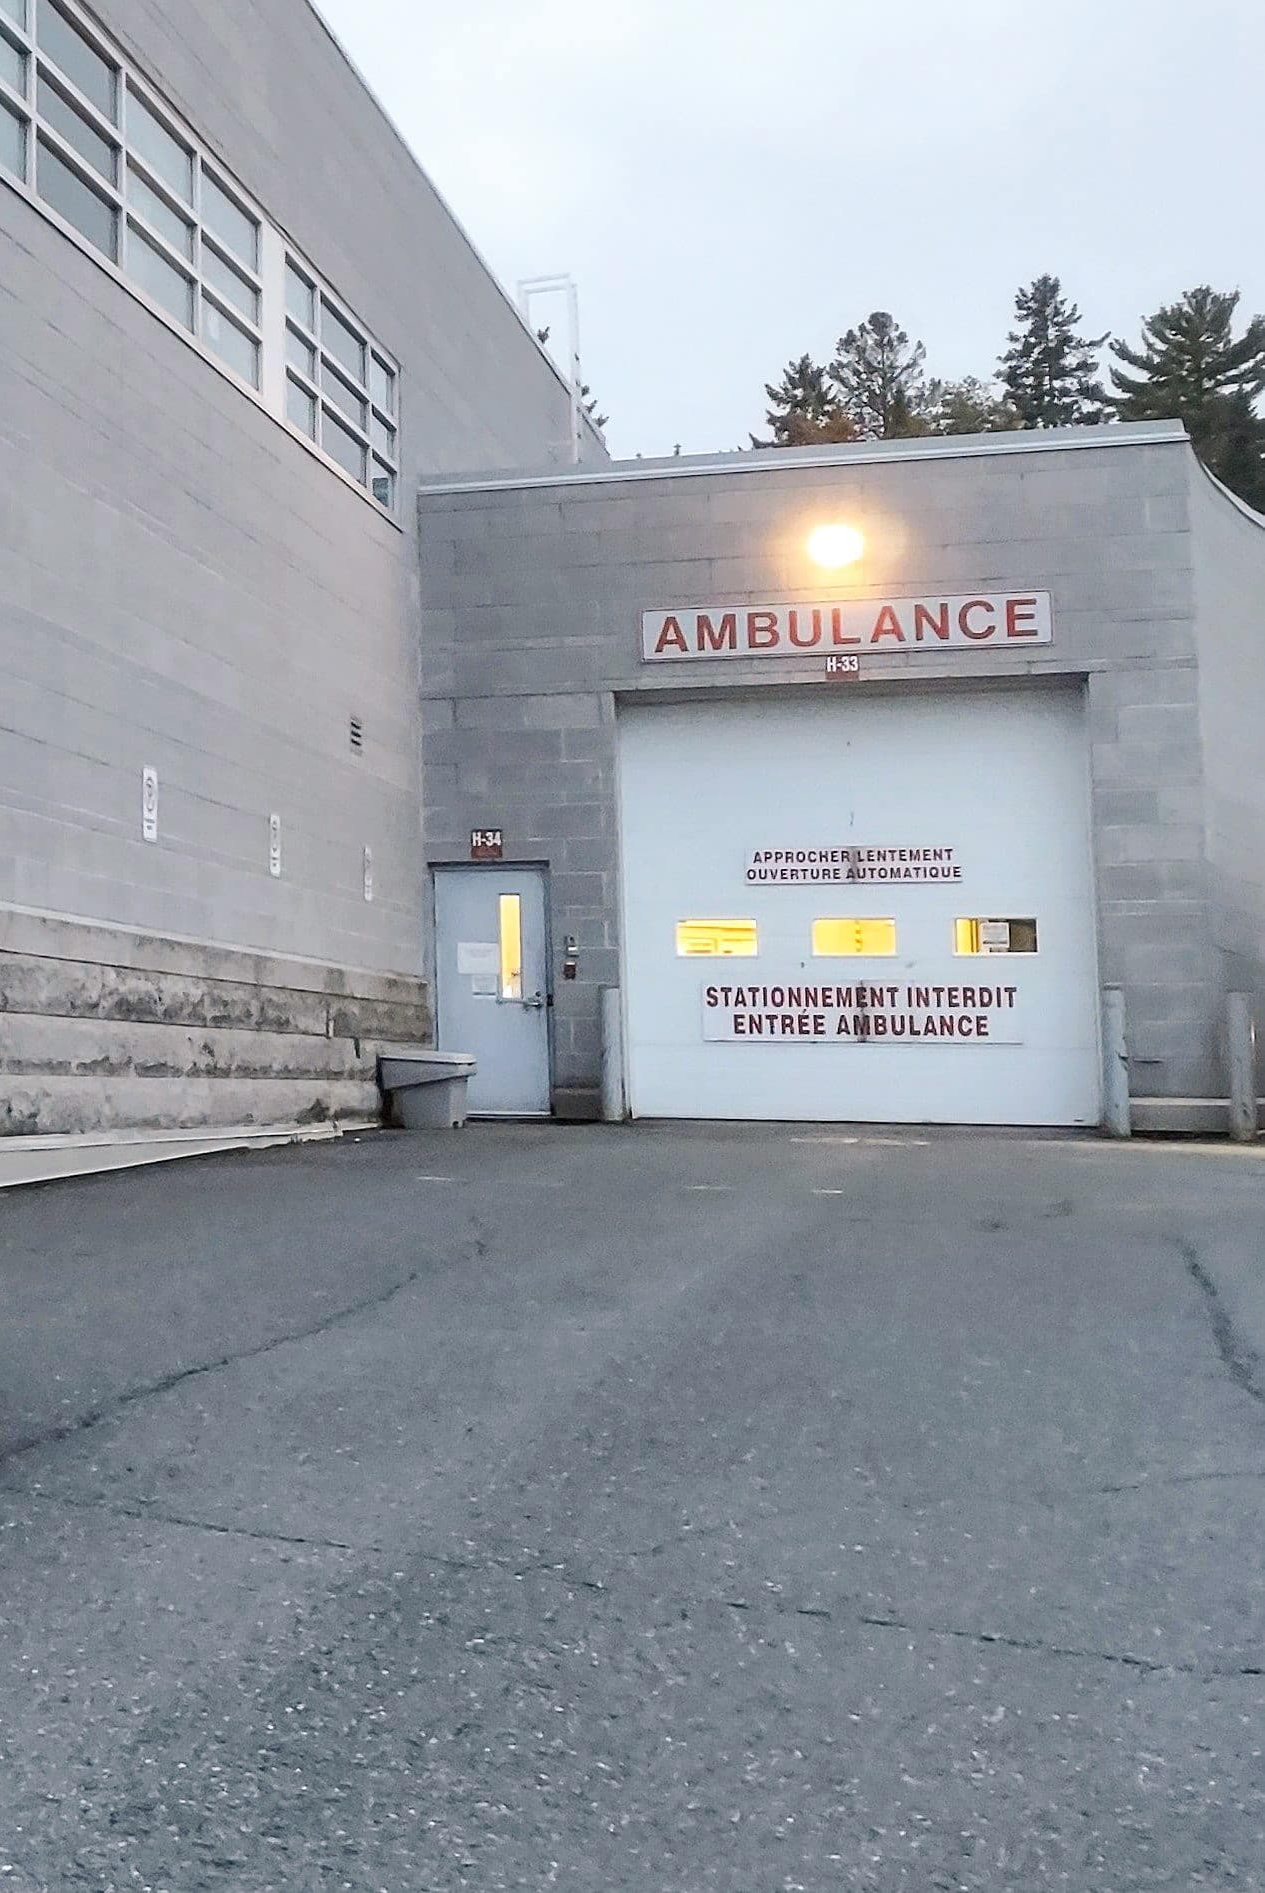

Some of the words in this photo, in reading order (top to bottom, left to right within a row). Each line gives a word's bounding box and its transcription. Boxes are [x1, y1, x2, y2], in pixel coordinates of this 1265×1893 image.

[654, 598, 1038, 653] AMBULANCE
[826, 655, 858, 672] H-33
[472, 832, 502, 847] H-34
[753, 850, 850, 864] APPROCHER
[857, 848, 953, 862] LENTEMENT
[747, 868, 840, 880] OUVERTURE
[846, 866, 962, 880] AUTOMATIQUE
[706, 986, 899, 1008] STATIONNEMENT
[907, 986, 1018, 1008] INTERDIT
[734, 1008, 826, 1035] ENTRÉE
[836, 1014, 989, 1036] AMBULANCE
